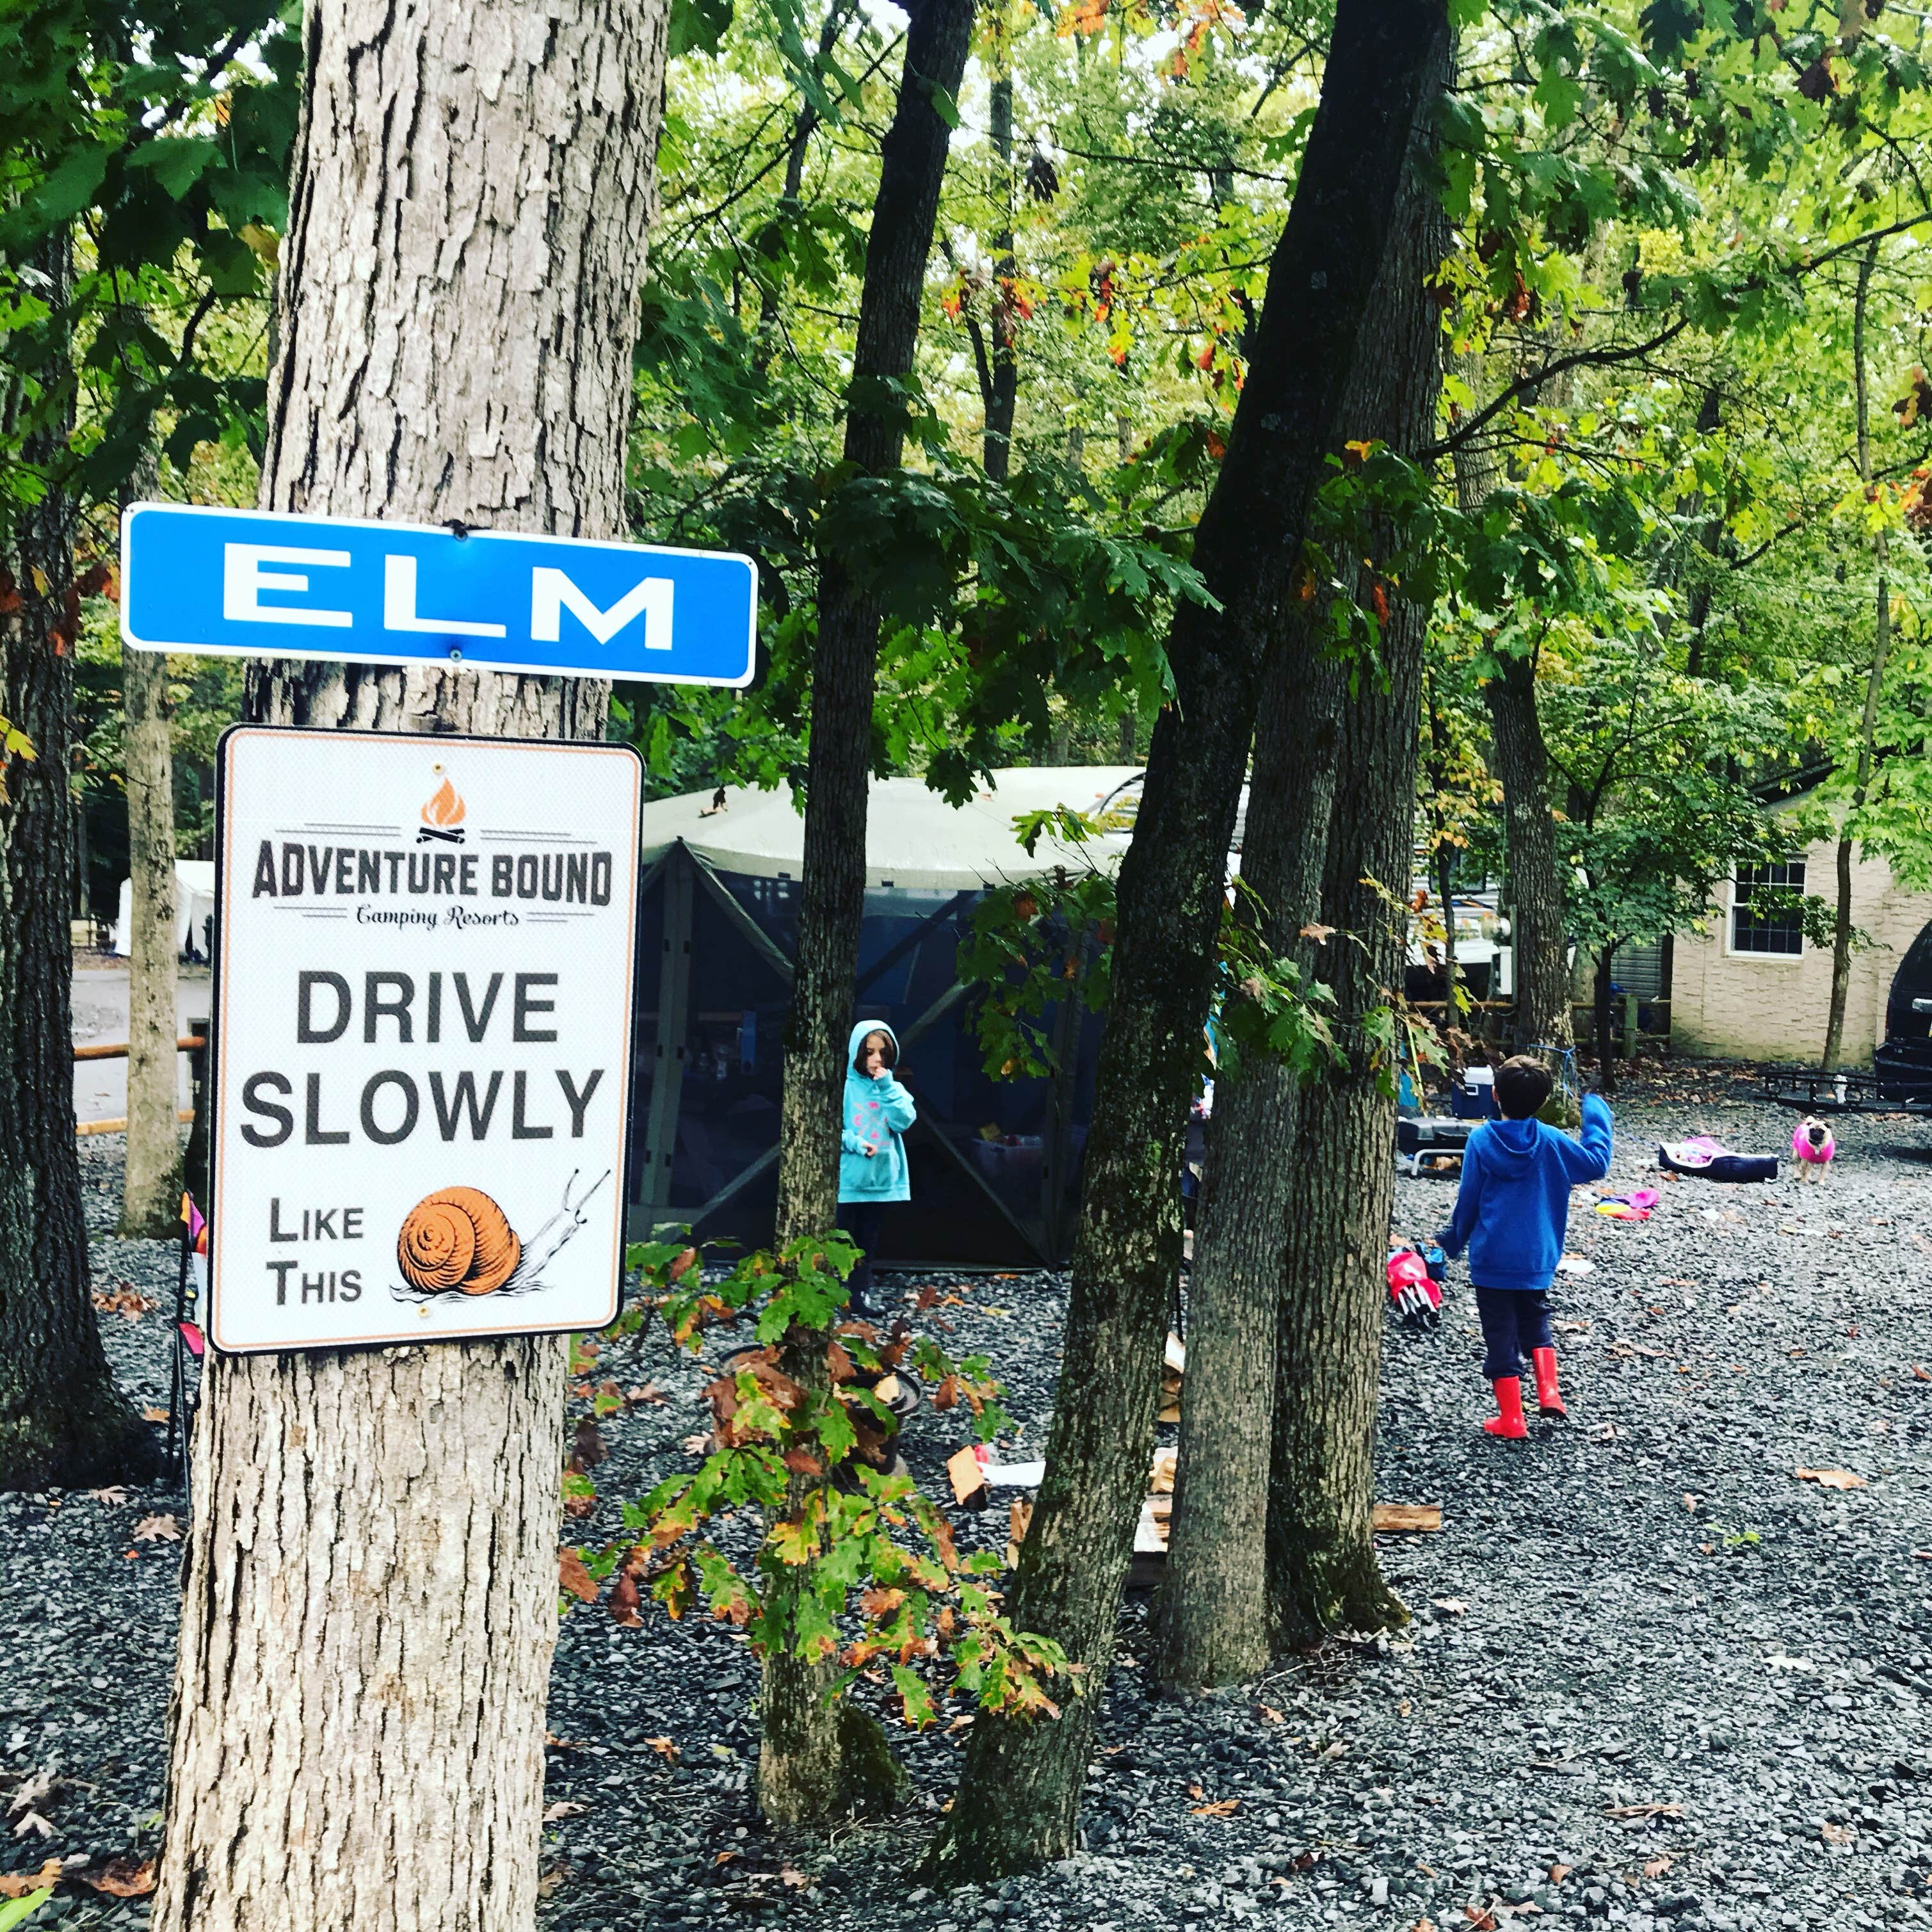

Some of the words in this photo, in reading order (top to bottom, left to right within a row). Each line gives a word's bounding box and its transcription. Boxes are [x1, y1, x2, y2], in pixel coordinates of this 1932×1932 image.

[223, 542, 675, 651] ELM
[252, 840, 478, 898] ADVENTURE
[492, 851, 612, 906] BOUND
[356, 905, 439, 931] Camping
[443, 906, 520, 930] Resorts
[296, 970, 558, 1043] DRIVE
[240, 1069, 605, 1148] SLOWLY
